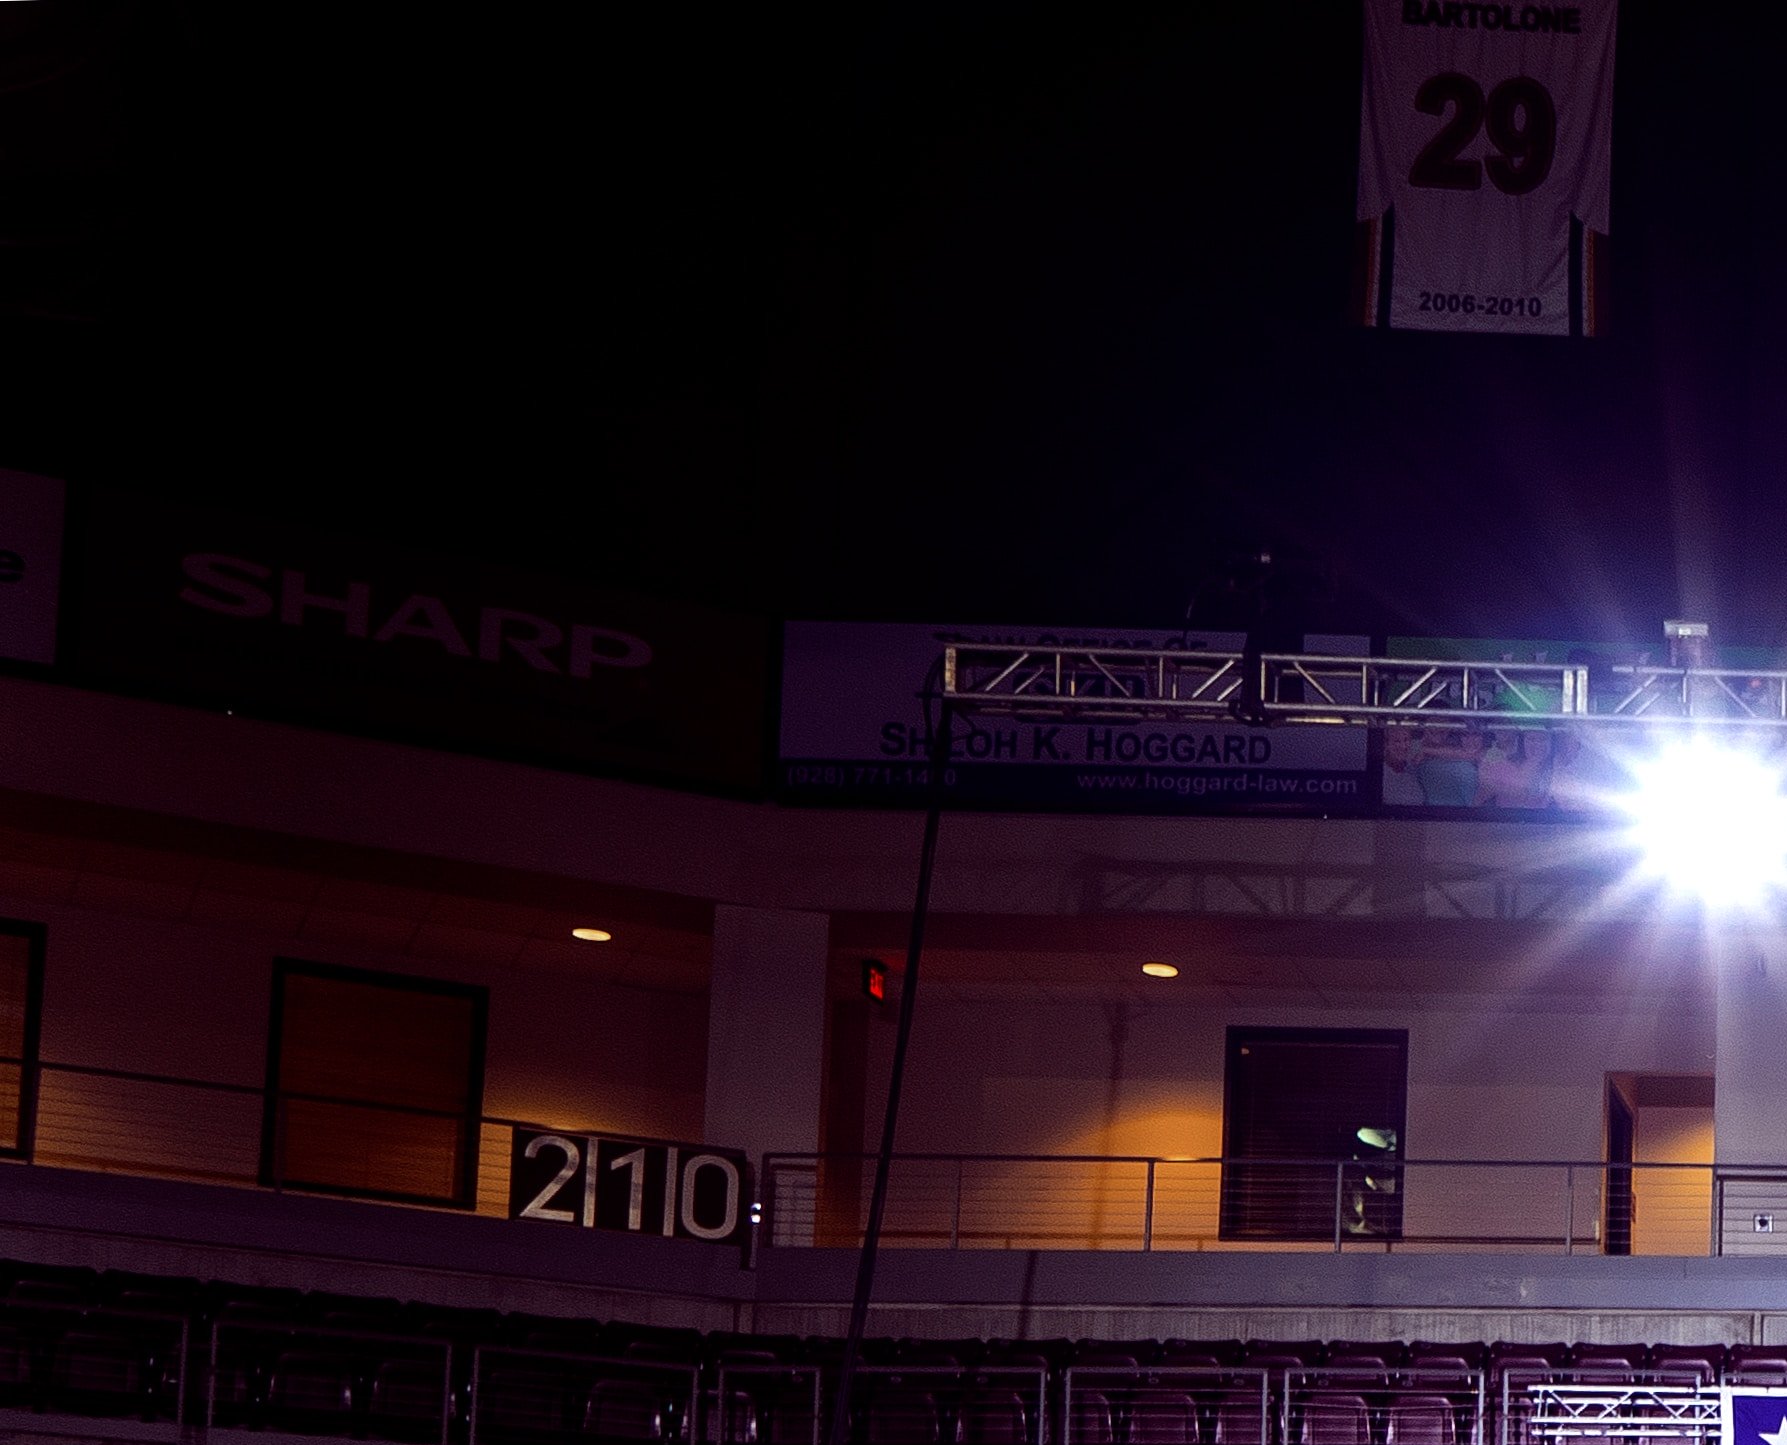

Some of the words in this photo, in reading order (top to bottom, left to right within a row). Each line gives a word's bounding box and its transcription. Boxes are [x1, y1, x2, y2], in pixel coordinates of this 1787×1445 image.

[1402, 0, 1581, 34] BARTOLONE
[1409, 71, 1557, 196] 29
[1418, 291, 1542, 317] 2006-2010
[178, 551, 654, 679] SHARP
[1032, 726, 1070, 760] K.
[1086, 728, 1272, 764] HOGGARD
[1077, 771, 1358, 796] www.hoggard-law.com
